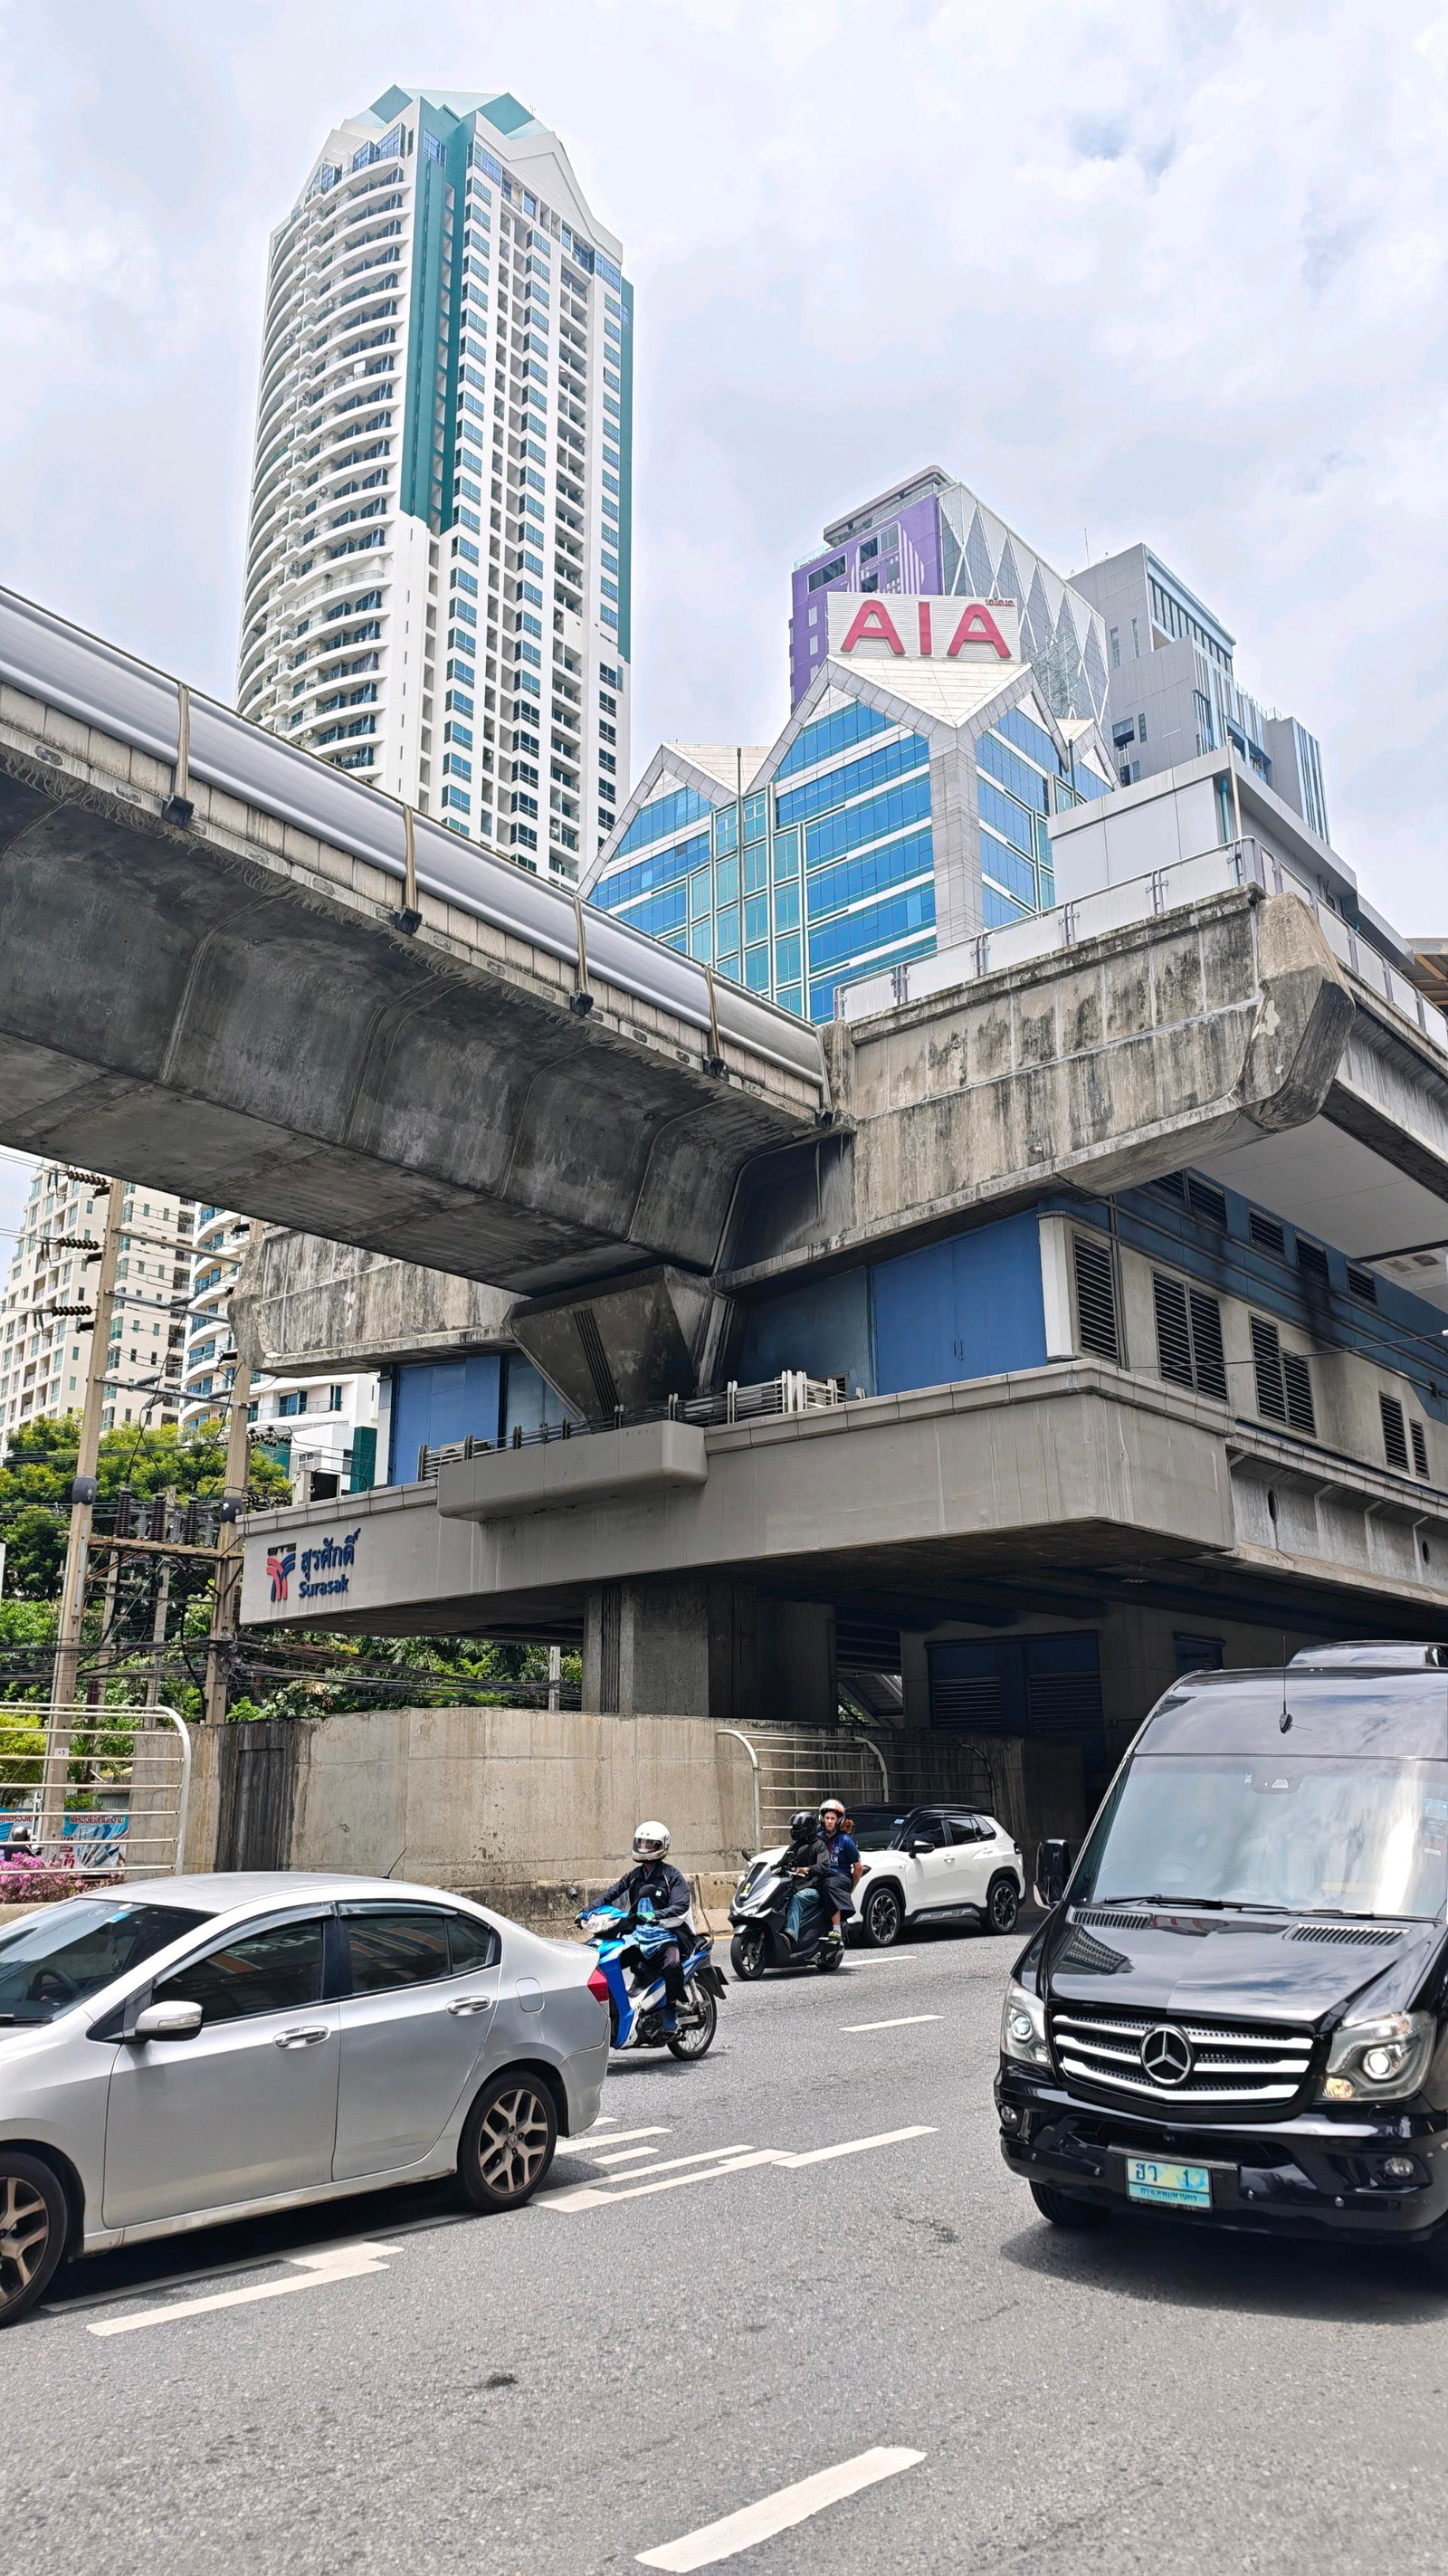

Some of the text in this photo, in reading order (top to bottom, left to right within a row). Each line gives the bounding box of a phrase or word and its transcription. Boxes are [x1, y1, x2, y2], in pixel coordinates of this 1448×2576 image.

[840, 599, 1012, 659] AIA
[267, 1542, 297, 1556] BTS
[300, 1527, 361, 1581] สุรศักดิ์
[299, 1574, 349, 1598] Surasak
